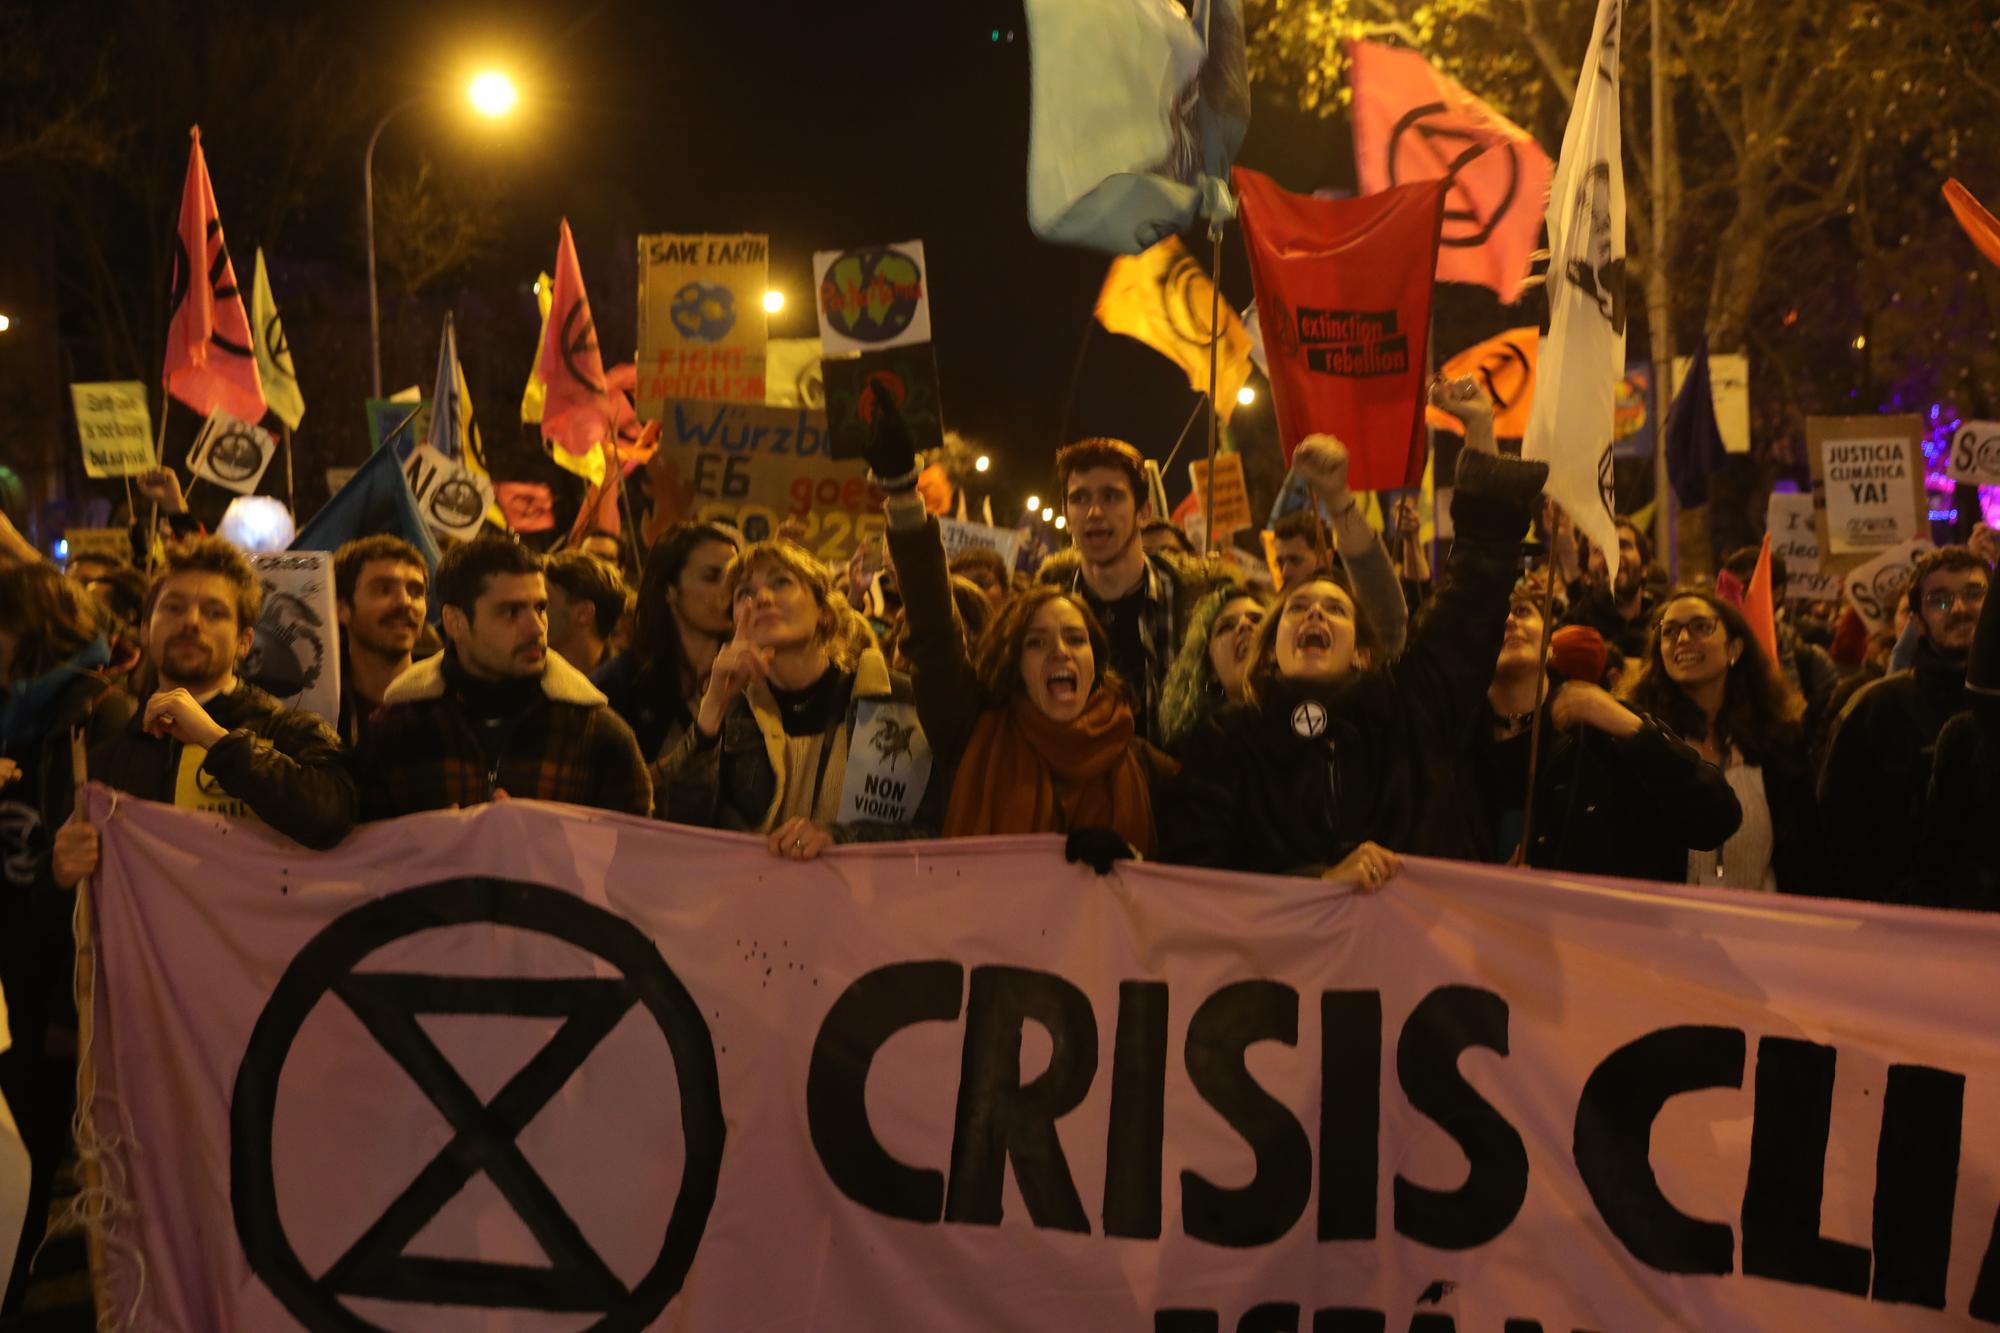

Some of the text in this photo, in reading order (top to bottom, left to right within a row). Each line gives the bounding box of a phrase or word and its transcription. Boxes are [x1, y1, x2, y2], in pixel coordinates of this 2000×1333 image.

[650, 239, 765, 266] SAVE EARTH
[1301, 311, 1385, 340] extinction
[658, 348, 745, 371] FIGHT
[1324, 344, 1405, 374] rebellion
[637, 373, 766, 402] CAPITALISM
[1829, 444, 1905, 464] JUSTICIA
[1829, 463, 1905, 482] CLIMÁTICA
[790, 476, 882, 519] goes
[1849, 483, 1888, 505] YA!
[864, 774, 907, 803] NON
[855, 795, 907, 821] VIOLENT
[807, 959, 2000, 1326] CRISIS CLI
